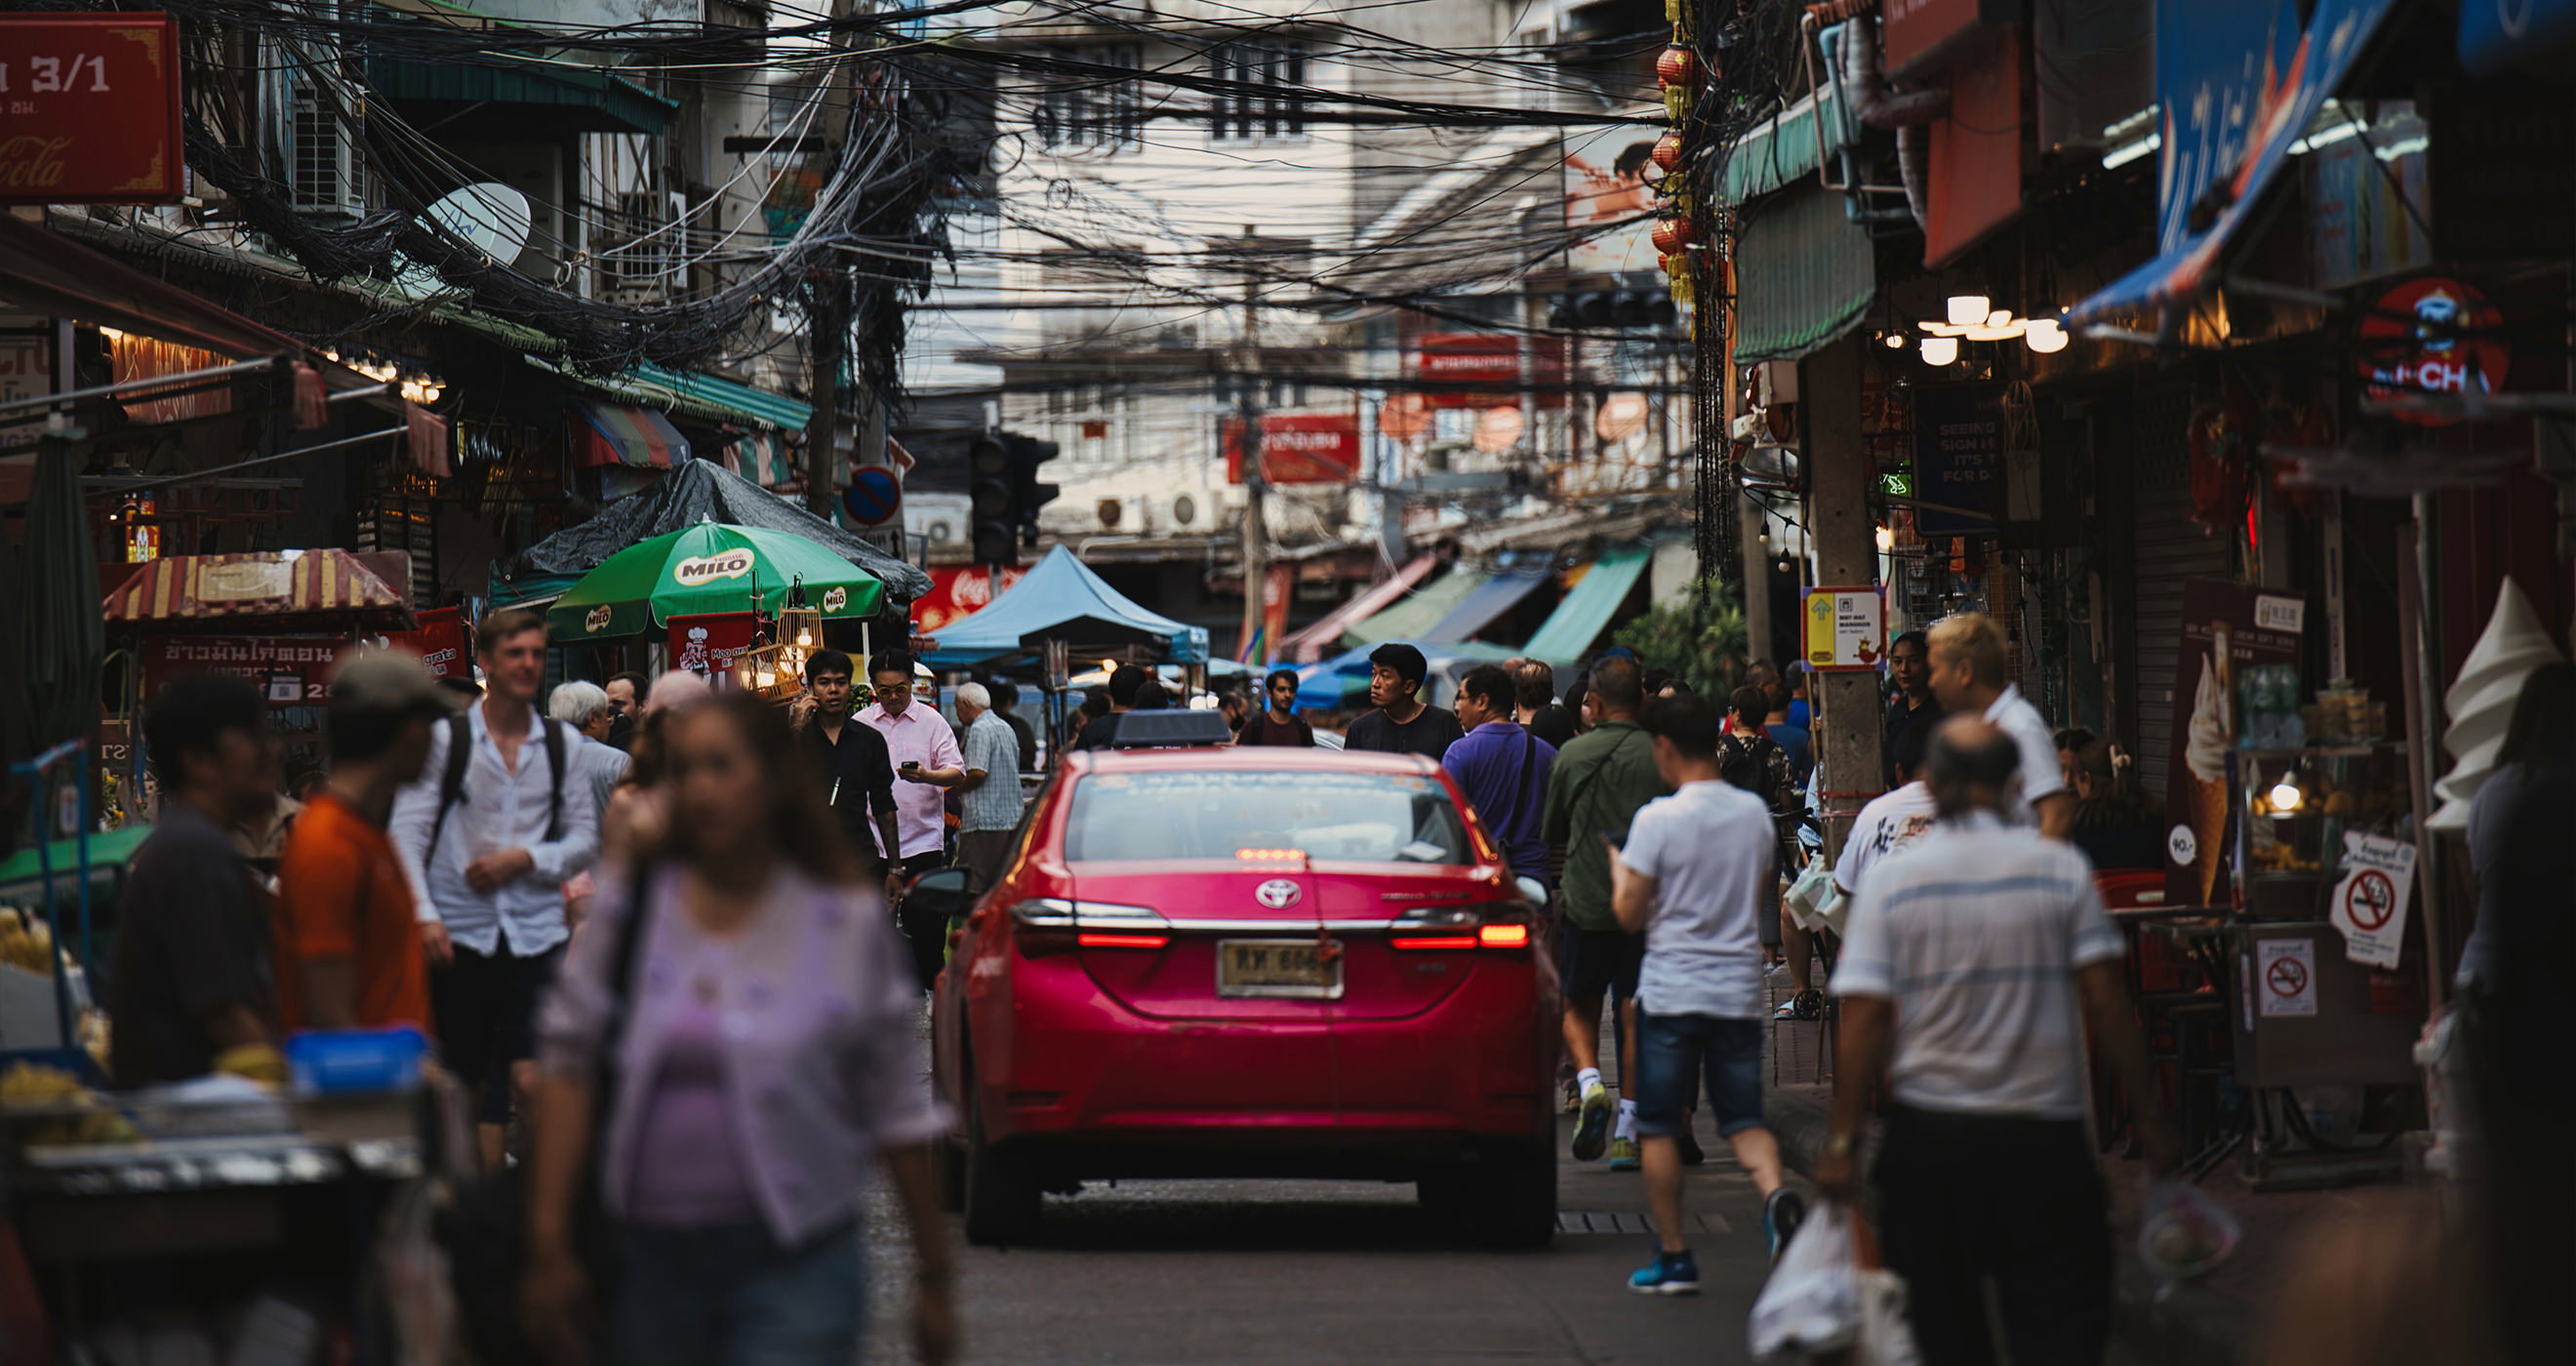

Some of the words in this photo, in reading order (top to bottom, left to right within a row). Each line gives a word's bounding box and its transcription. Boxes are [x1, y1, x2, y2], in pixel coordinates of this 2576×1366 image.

[31, 53, 110, 93] 3/1
[1939, 422, 1996, 436] SEEING
[1941, 438, 1977, 451] SIGN
[1954, 454, 1983, 465] IT'S
[682, 559, 746, 578] MILO
[825, 595, 844, 606] MILO
[587, 614, 609, 626] MILO
[165, 639, 334, 663] ข้าวมันไก่ตอน
[712, 649, 731, 659] Moo
[425, 651, 456, 665] grata
